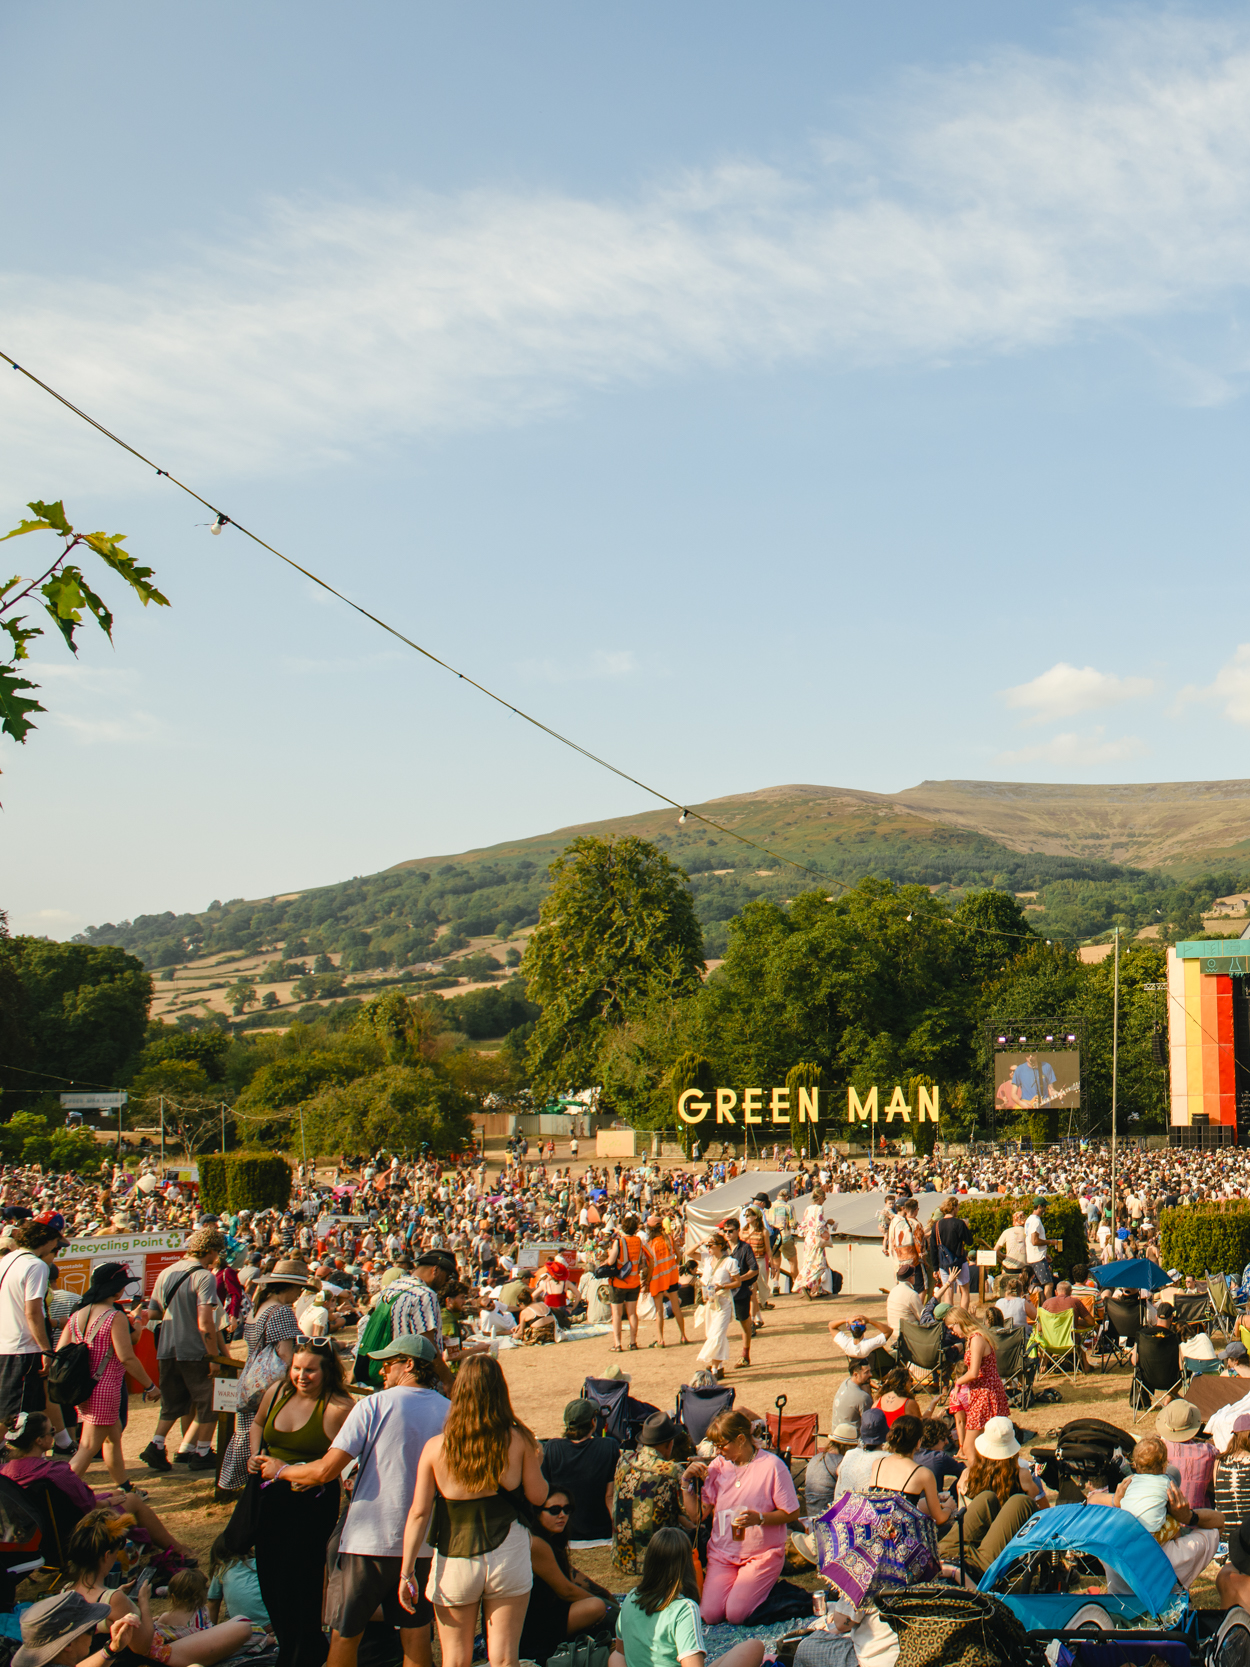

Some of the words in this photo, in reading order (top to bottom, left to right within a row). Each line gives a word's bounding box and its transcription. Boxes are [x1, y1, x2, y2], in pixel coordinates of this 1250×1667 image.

[678, 1087, 819, 1124] GREEN
[848, 1085, 939, 1123] MAN
[71, 1240, 129, 1253] Recycling
[132, 1237, 163, 1248] Point
